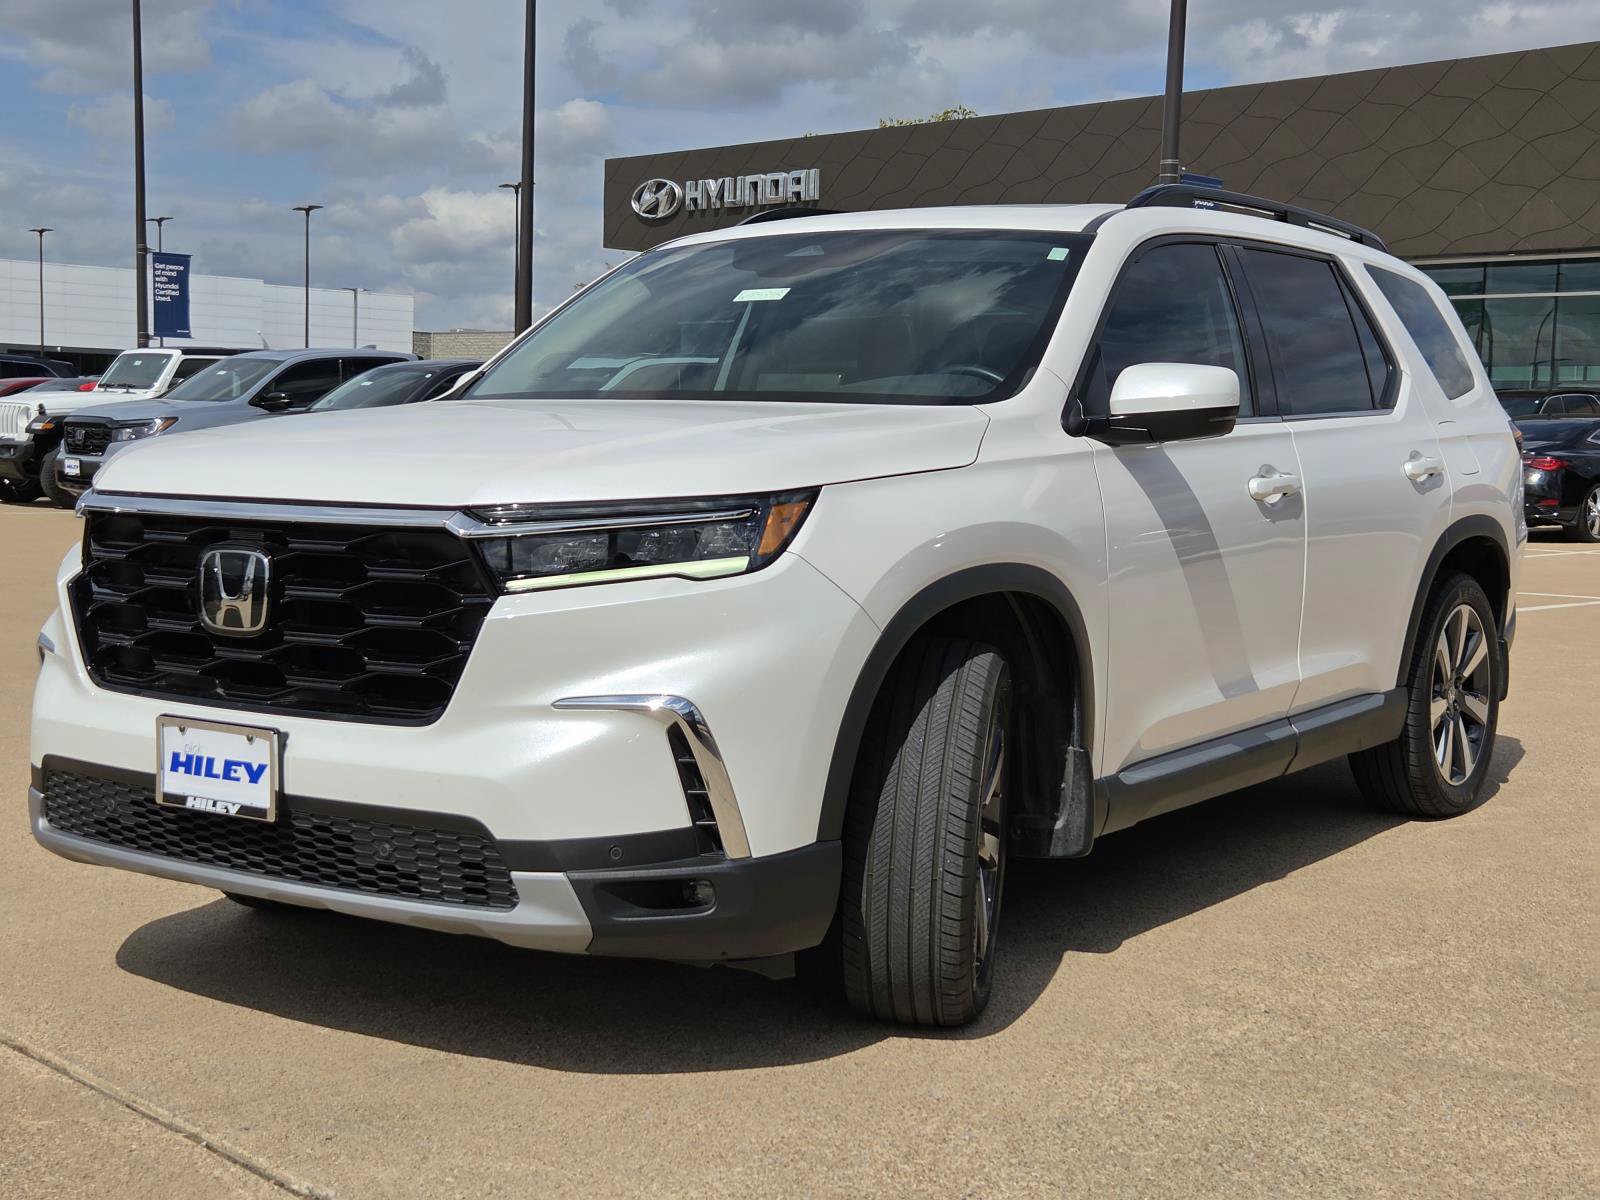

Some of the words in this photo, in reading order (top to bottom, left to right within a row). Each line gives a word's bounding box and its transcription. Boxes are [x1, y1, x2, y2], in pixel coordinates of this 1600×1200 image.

[685, 168, 820, 211] HYUNDAI
[170, 751, 268, 784] HILEY
[186, 796, 241, 815] HILEY
